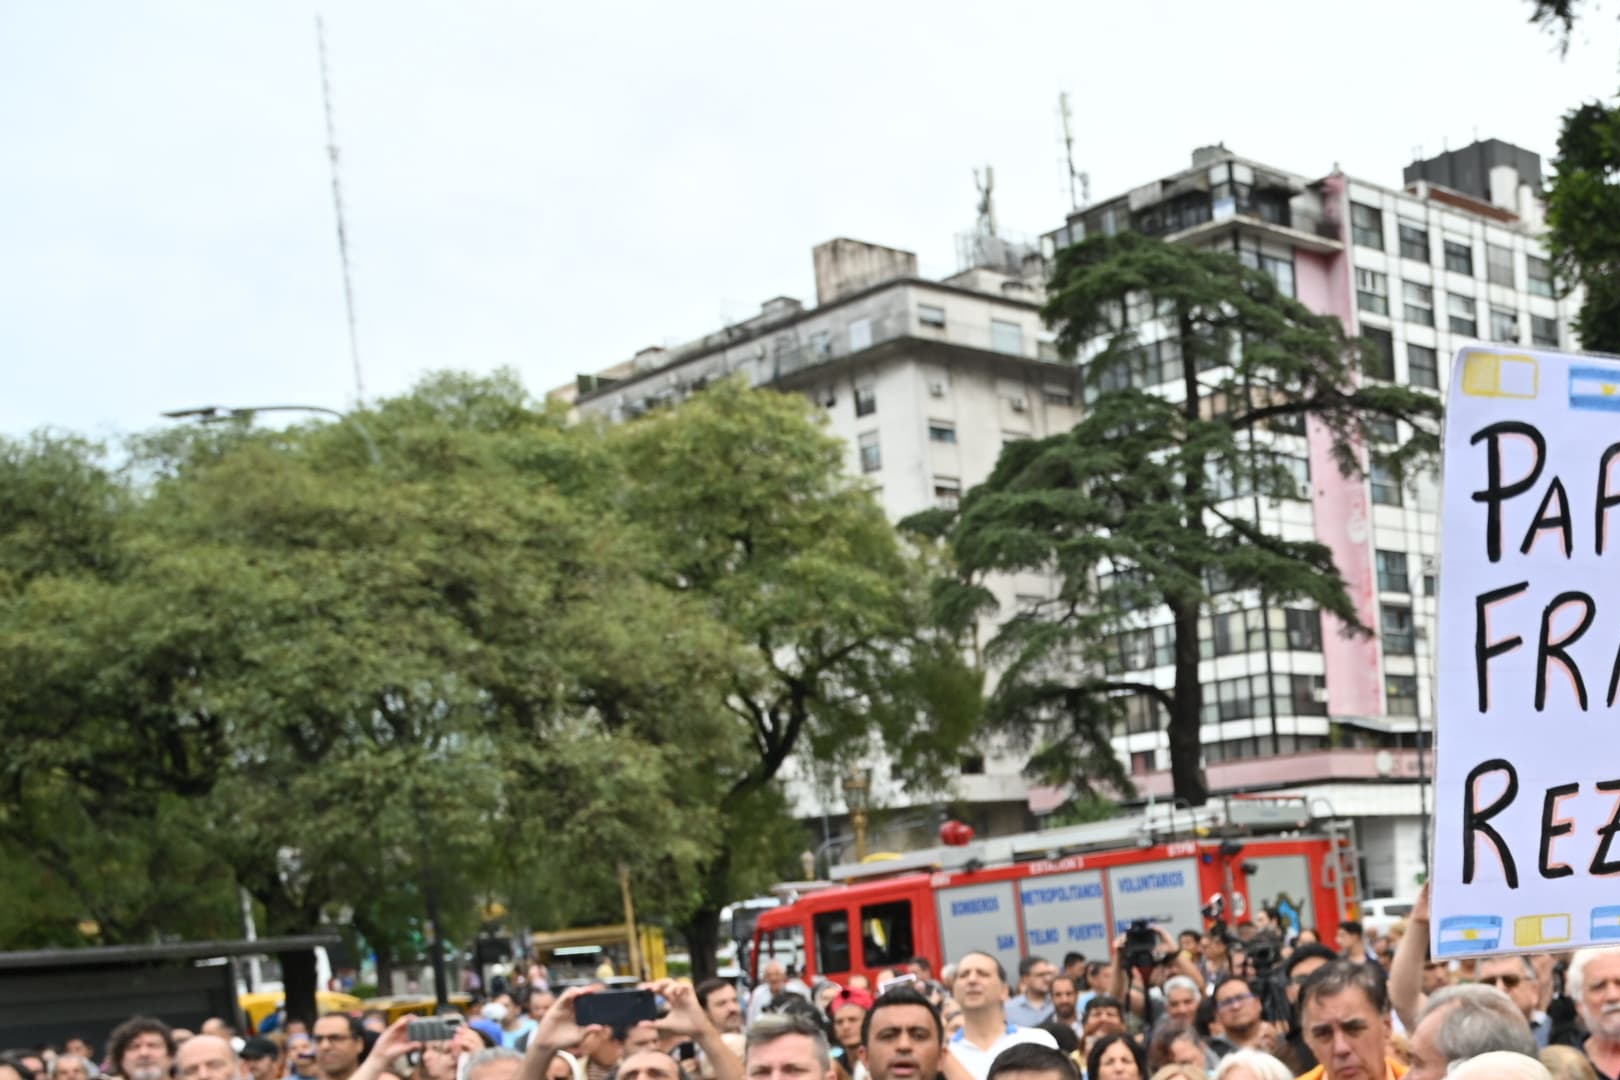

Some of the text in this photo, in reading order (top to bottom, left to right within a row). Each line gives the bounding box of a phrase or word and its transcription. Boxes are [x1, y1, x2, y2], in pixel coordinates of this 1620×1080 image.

[1118, 870, 1184, 893] VOLUNTARIOS
[1028, 928, 1060, 946] TELMO
[1067, 922, 1105, 942] PUERTO
